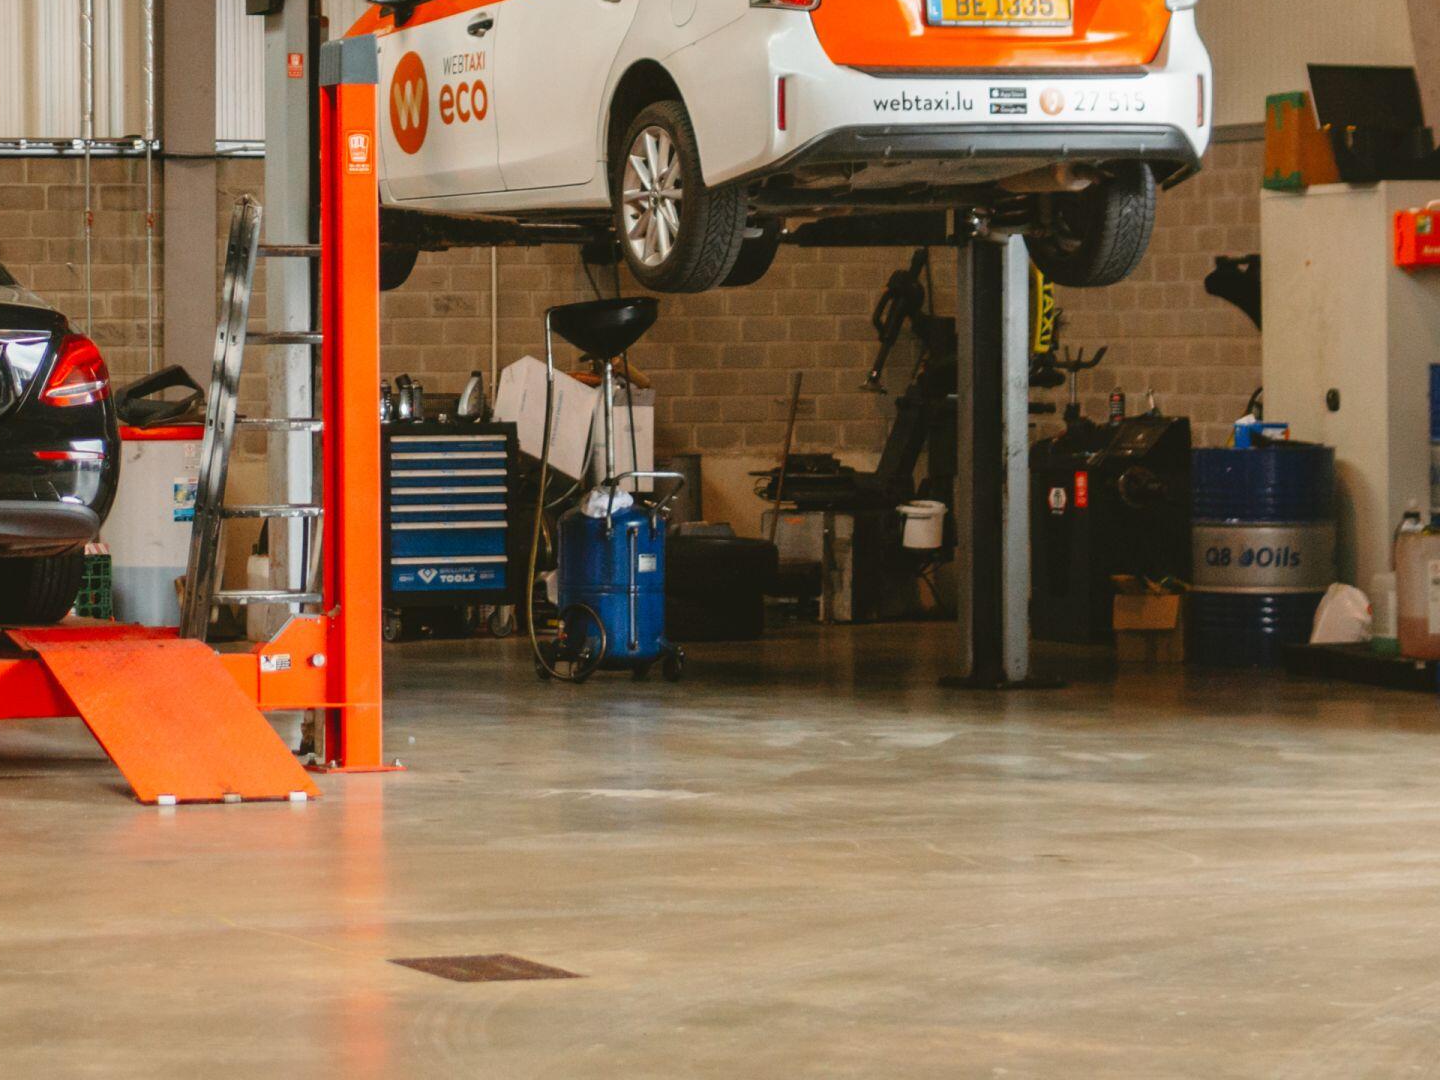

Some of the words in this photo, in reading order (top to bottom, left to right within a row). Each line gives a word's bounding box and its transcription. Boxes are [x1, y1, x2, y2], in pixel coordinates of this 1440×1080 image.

[442, 51, 486, 75] WEBTAXI
[439, 79, 488, 125] eco
[873, 90, 973, 112] webtaxi.lu
[1074, 90, 1101, 112] 27
[1109, 89, 1146, 112] 515
[1041, 282, 1056, 341] TAXI
[1206, 547, 1231, 567] Q8
[1256, 546, 1300, 567] Oils
[440, 573, 475, 583] TOOLS
